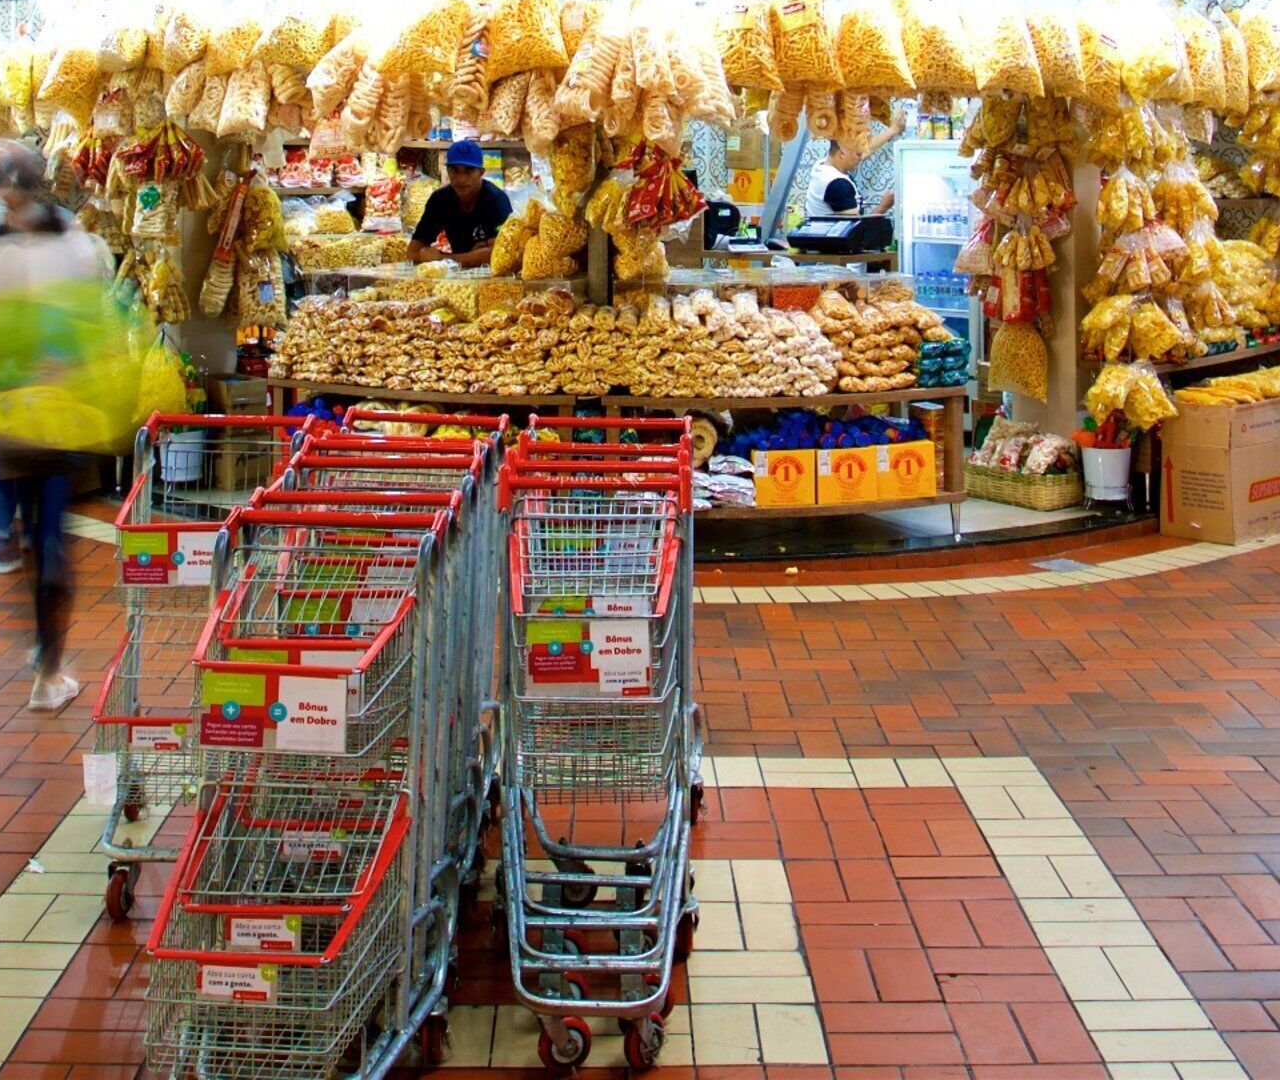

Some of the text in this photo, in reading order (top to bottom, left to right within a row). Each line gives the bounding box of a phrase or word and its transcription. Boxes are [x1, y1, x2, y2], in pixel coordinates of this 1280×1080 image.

[607, 604, 633, 612] Bônus
[605, 635, 633, 643] Bônus
[614, 647, 643, 655] Dobro
[298, 702, 329, 713] Bônus
[307, 716, 338, 726] Dobro
